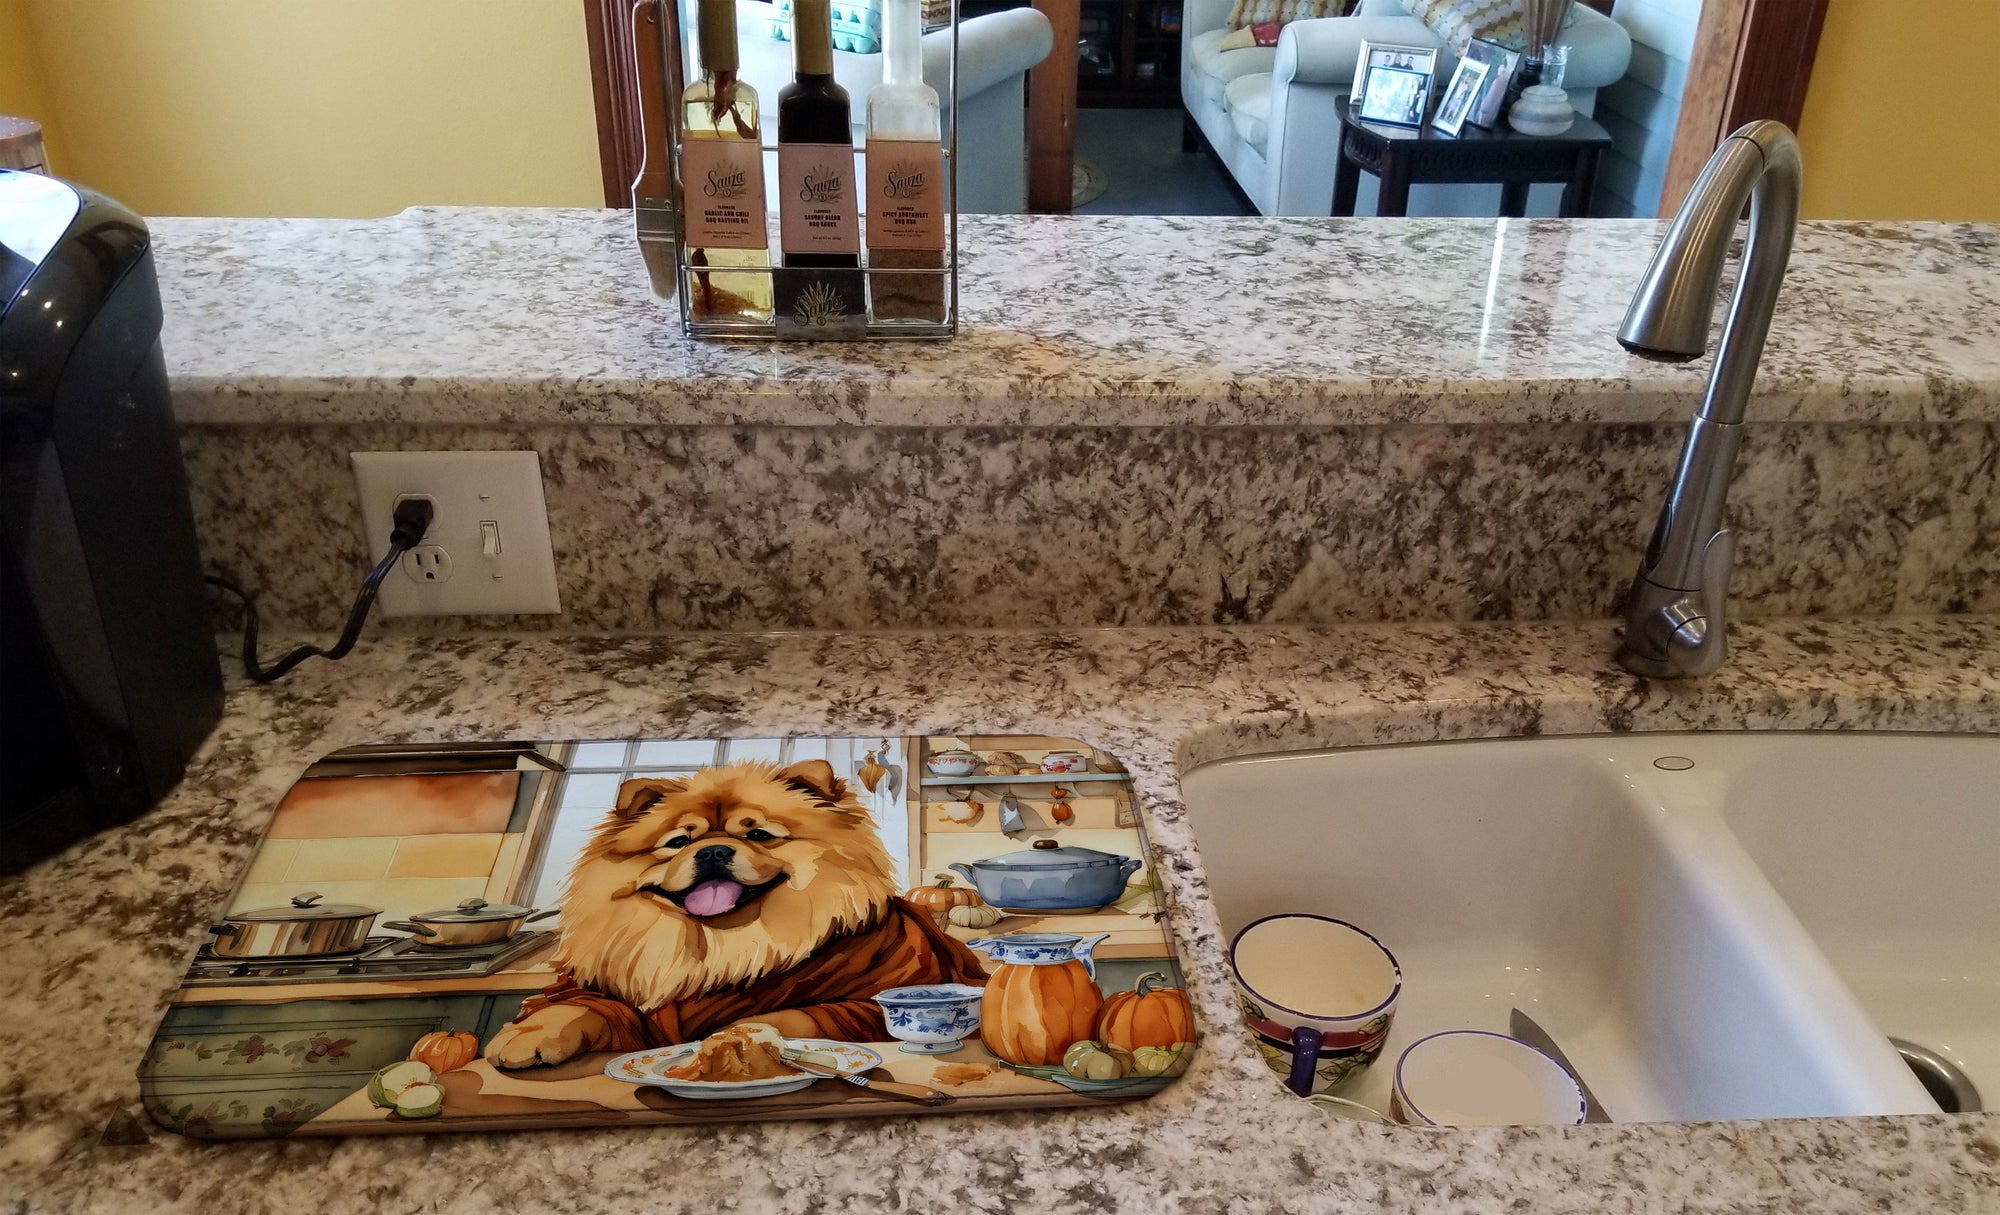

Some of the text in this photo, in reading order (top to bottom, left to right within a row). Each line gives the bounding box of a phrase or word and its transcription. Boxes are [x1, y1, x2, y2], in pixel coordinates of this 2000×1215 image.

[703, 170, 746, 197] Sauza
[800, 175, 841, 202] Sauza
[883, 171, 925, 198] Sauza
